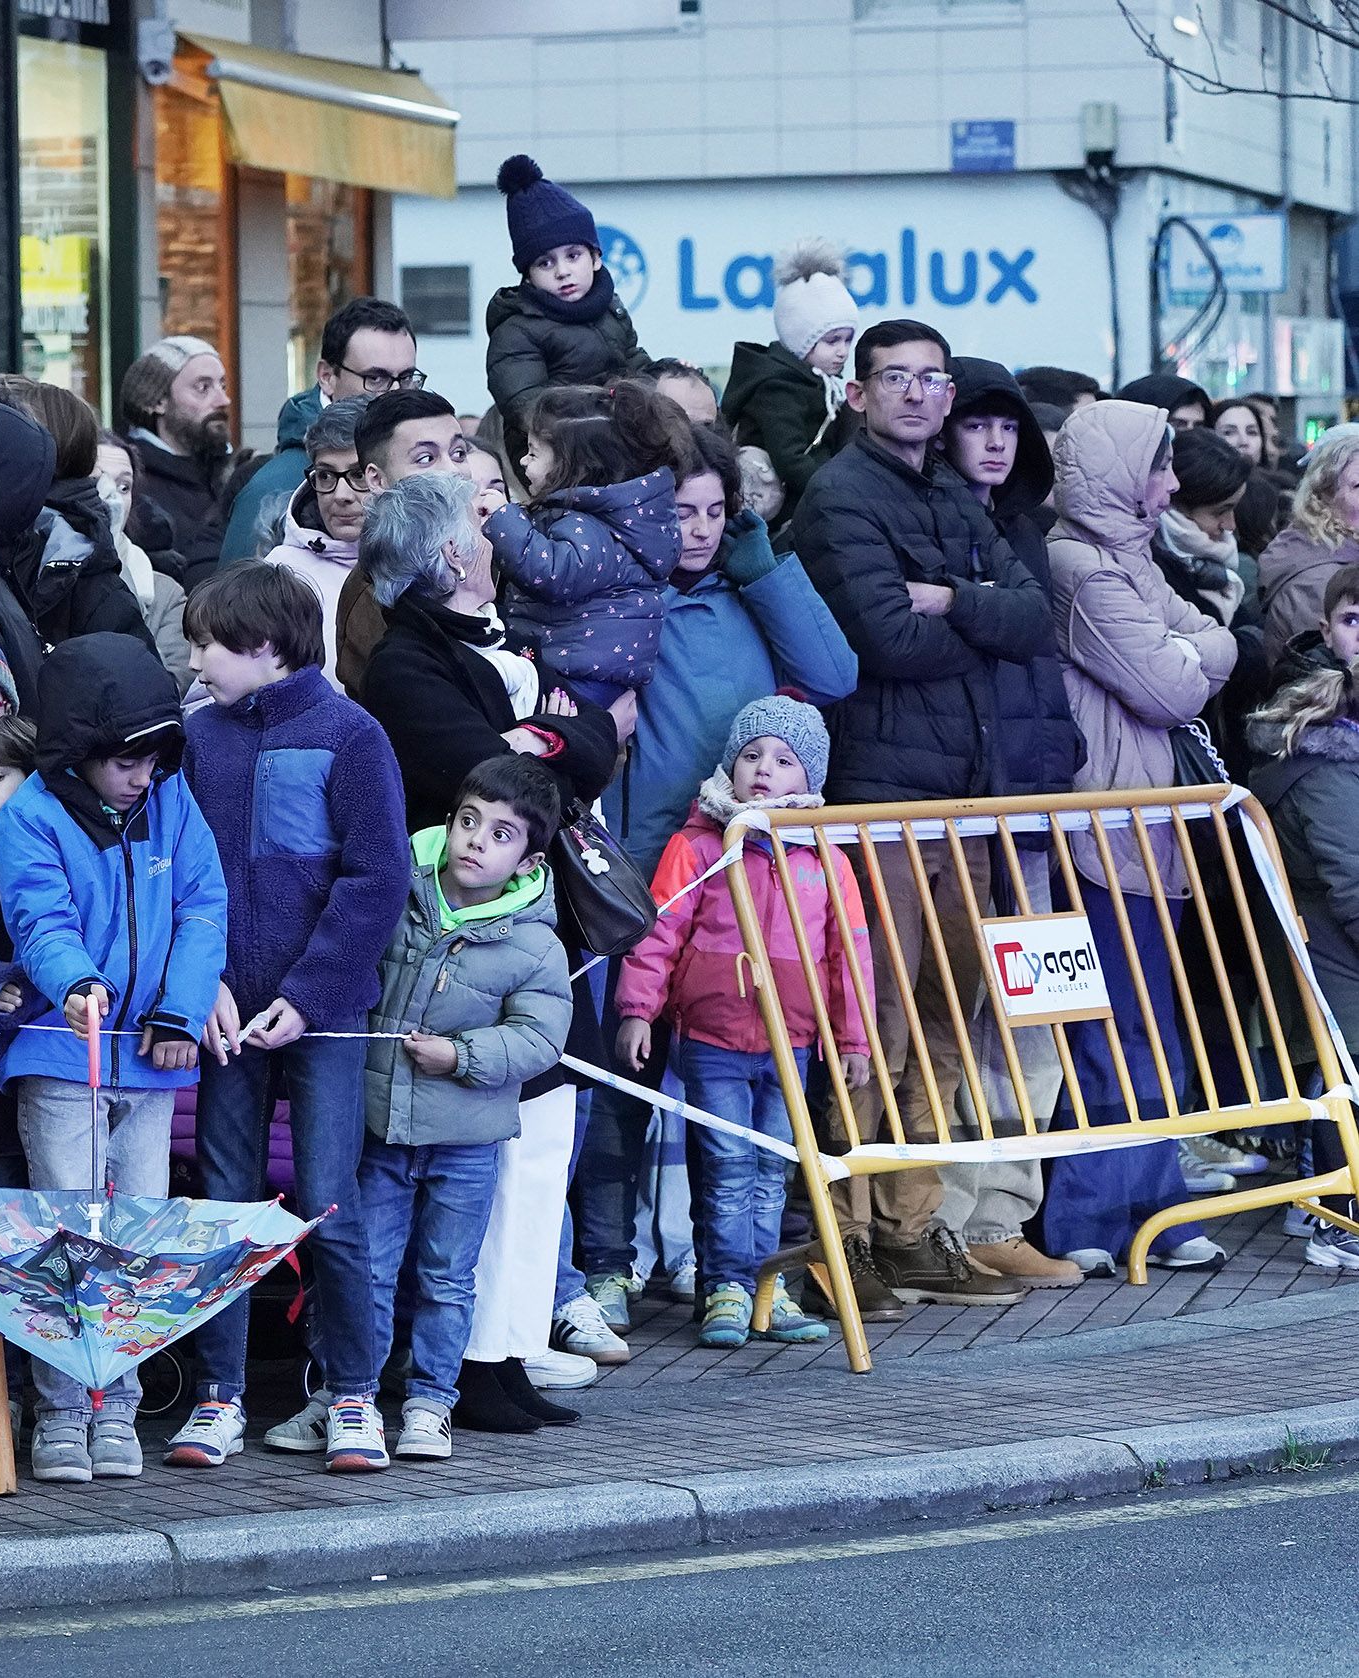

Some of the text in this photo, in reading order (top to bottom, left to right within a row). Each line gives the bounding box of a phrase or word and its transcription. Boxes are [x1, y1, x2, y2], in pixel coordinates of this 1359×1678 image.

[678, 228, 1040, 311] Laalux
[1003, 941, 1097, 989] Myagal
[1047, 981, 1089, 994] ALQUILER
